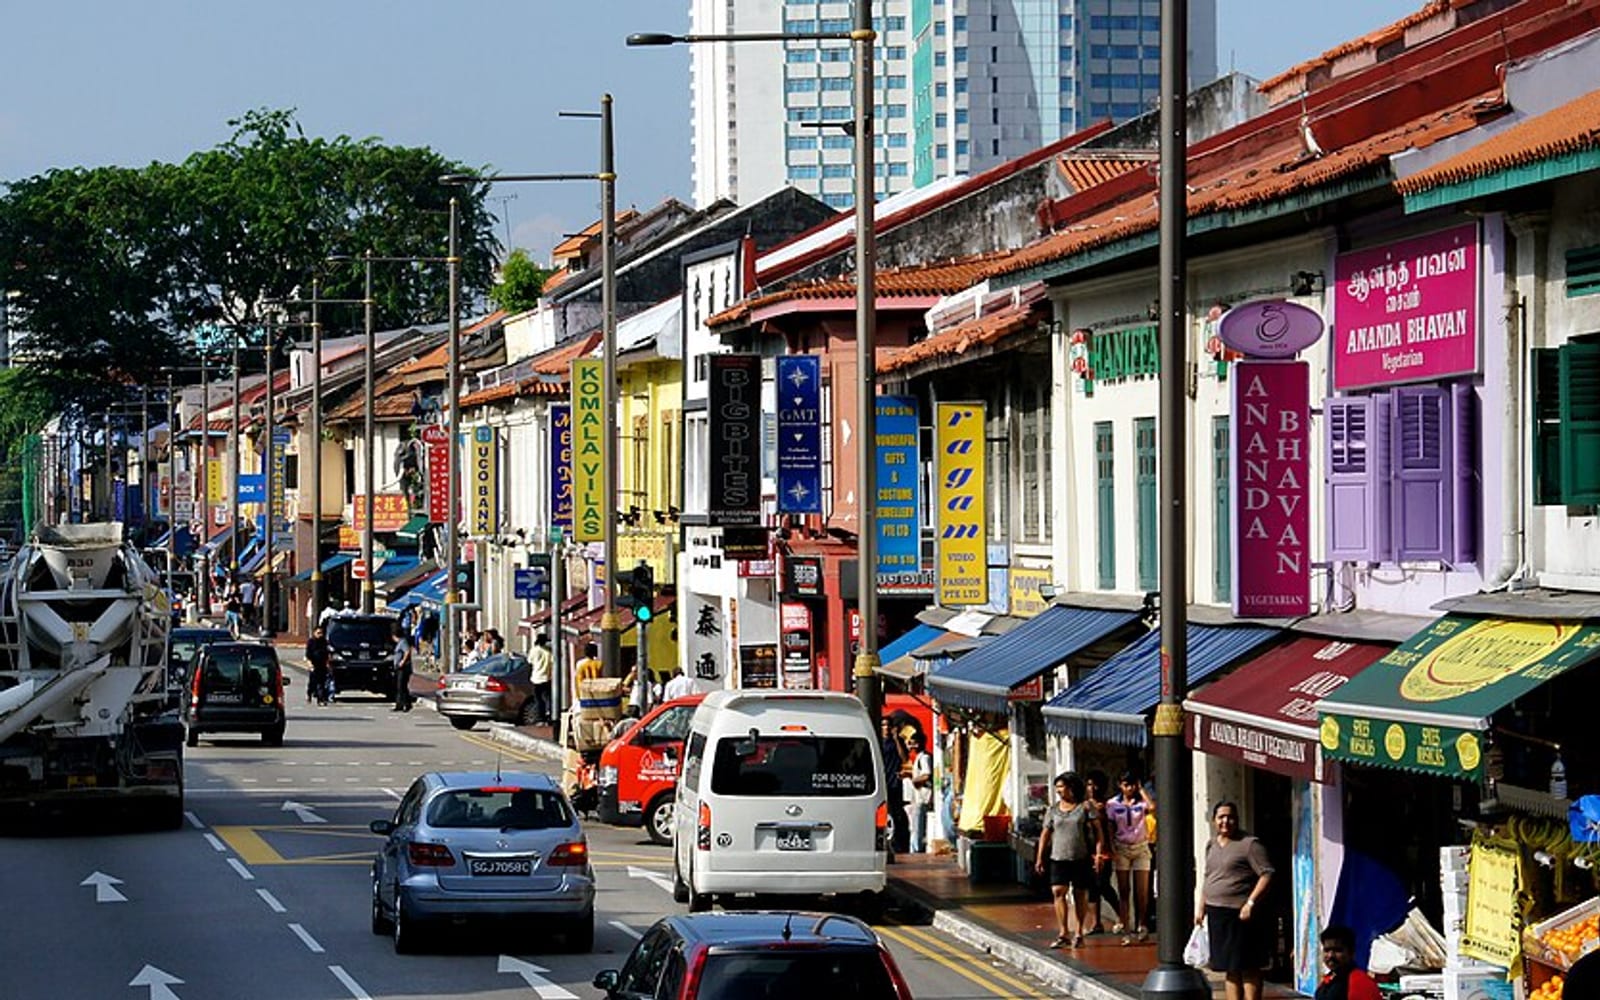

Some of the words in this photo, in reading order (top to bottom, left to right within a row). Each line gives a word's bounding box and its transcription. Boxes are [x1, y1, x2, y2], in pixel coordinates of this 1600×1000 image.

[1347, 252, 1409, 303] ஆனந்த
[1416, 236, 1467, 279] பவன்
[1346, 321, 1402, 354] ANANDA
[1407, 309, 1467, 344] BHAVAN
[1382, 349, 1424, 374] Vegetarian
[580, 366, 600, 455] KOMALA
[721, 368, 750, 419] BIG
[779, 409, 817, 422] GMT
[478, 446, 489, 481] UCO
[721, 422, 750, 506] BITES
[942, 411, 980, 539] ragam
[1245, 374, 1270, 539] ANANDA
[478, 485, 489, 531] BANK
[582, 462, 600, 535] VILAS
[1276, 410, 1301, 574] BHAVAN
[947, 553, 975, 562] VIDEO
[958, 565, 965, 574] &
[942, 577, 981, 588] FASHION
[944, 590, 962, 599] PTE
[964, 590, 980, 599] LTD
[1243, 594, 1304, 605] VEGETARIAN
[1209, 721, 1237, 748] ANANDA
[1237, 726, 1264, 753] BHAVAN
[1264, 732, 1306, 763] VEGETARIAN
[812, 773, 828, 782] FOR
[830, 773, 867, 783] BOOKING
[473, 861, 530, 874] SGJ7058C
